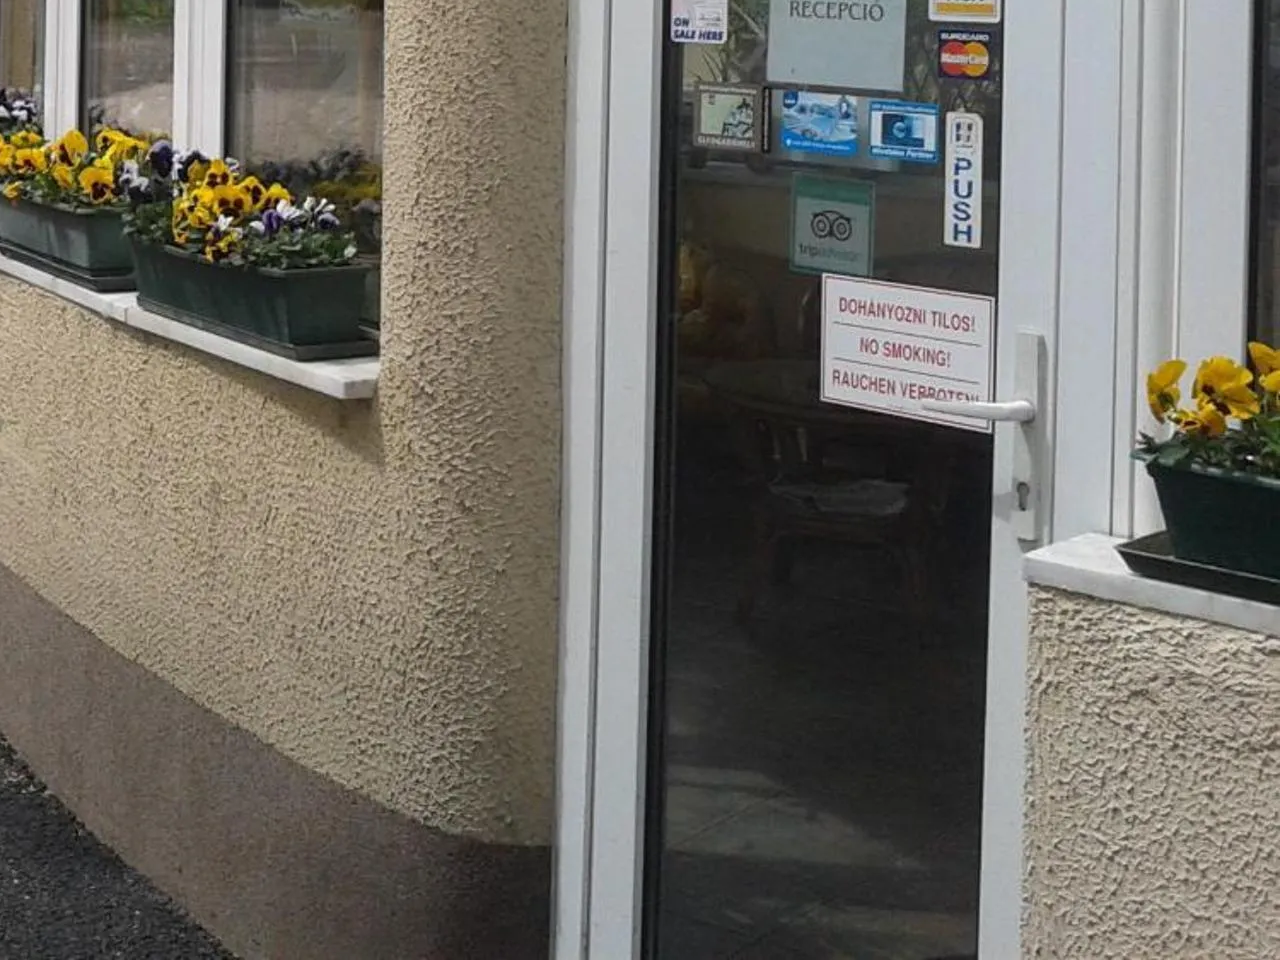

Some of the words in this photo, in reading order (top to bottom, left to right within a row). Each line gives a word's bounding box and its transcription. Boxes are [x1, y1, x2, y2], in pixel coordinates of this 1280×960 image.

[673, 17, 690, 27] ON
[674, 29, 697, 40] SALE
[698, 30, 724, 41] HERE
[952, 157, 973, 244] PUSH
[931, 310, 976, 333] TILOS!
[859, 337, 879, 355] NO
[882, 340, 952, 368] SMOKING!
[832, 368, 896, 397] RAUCHEN
